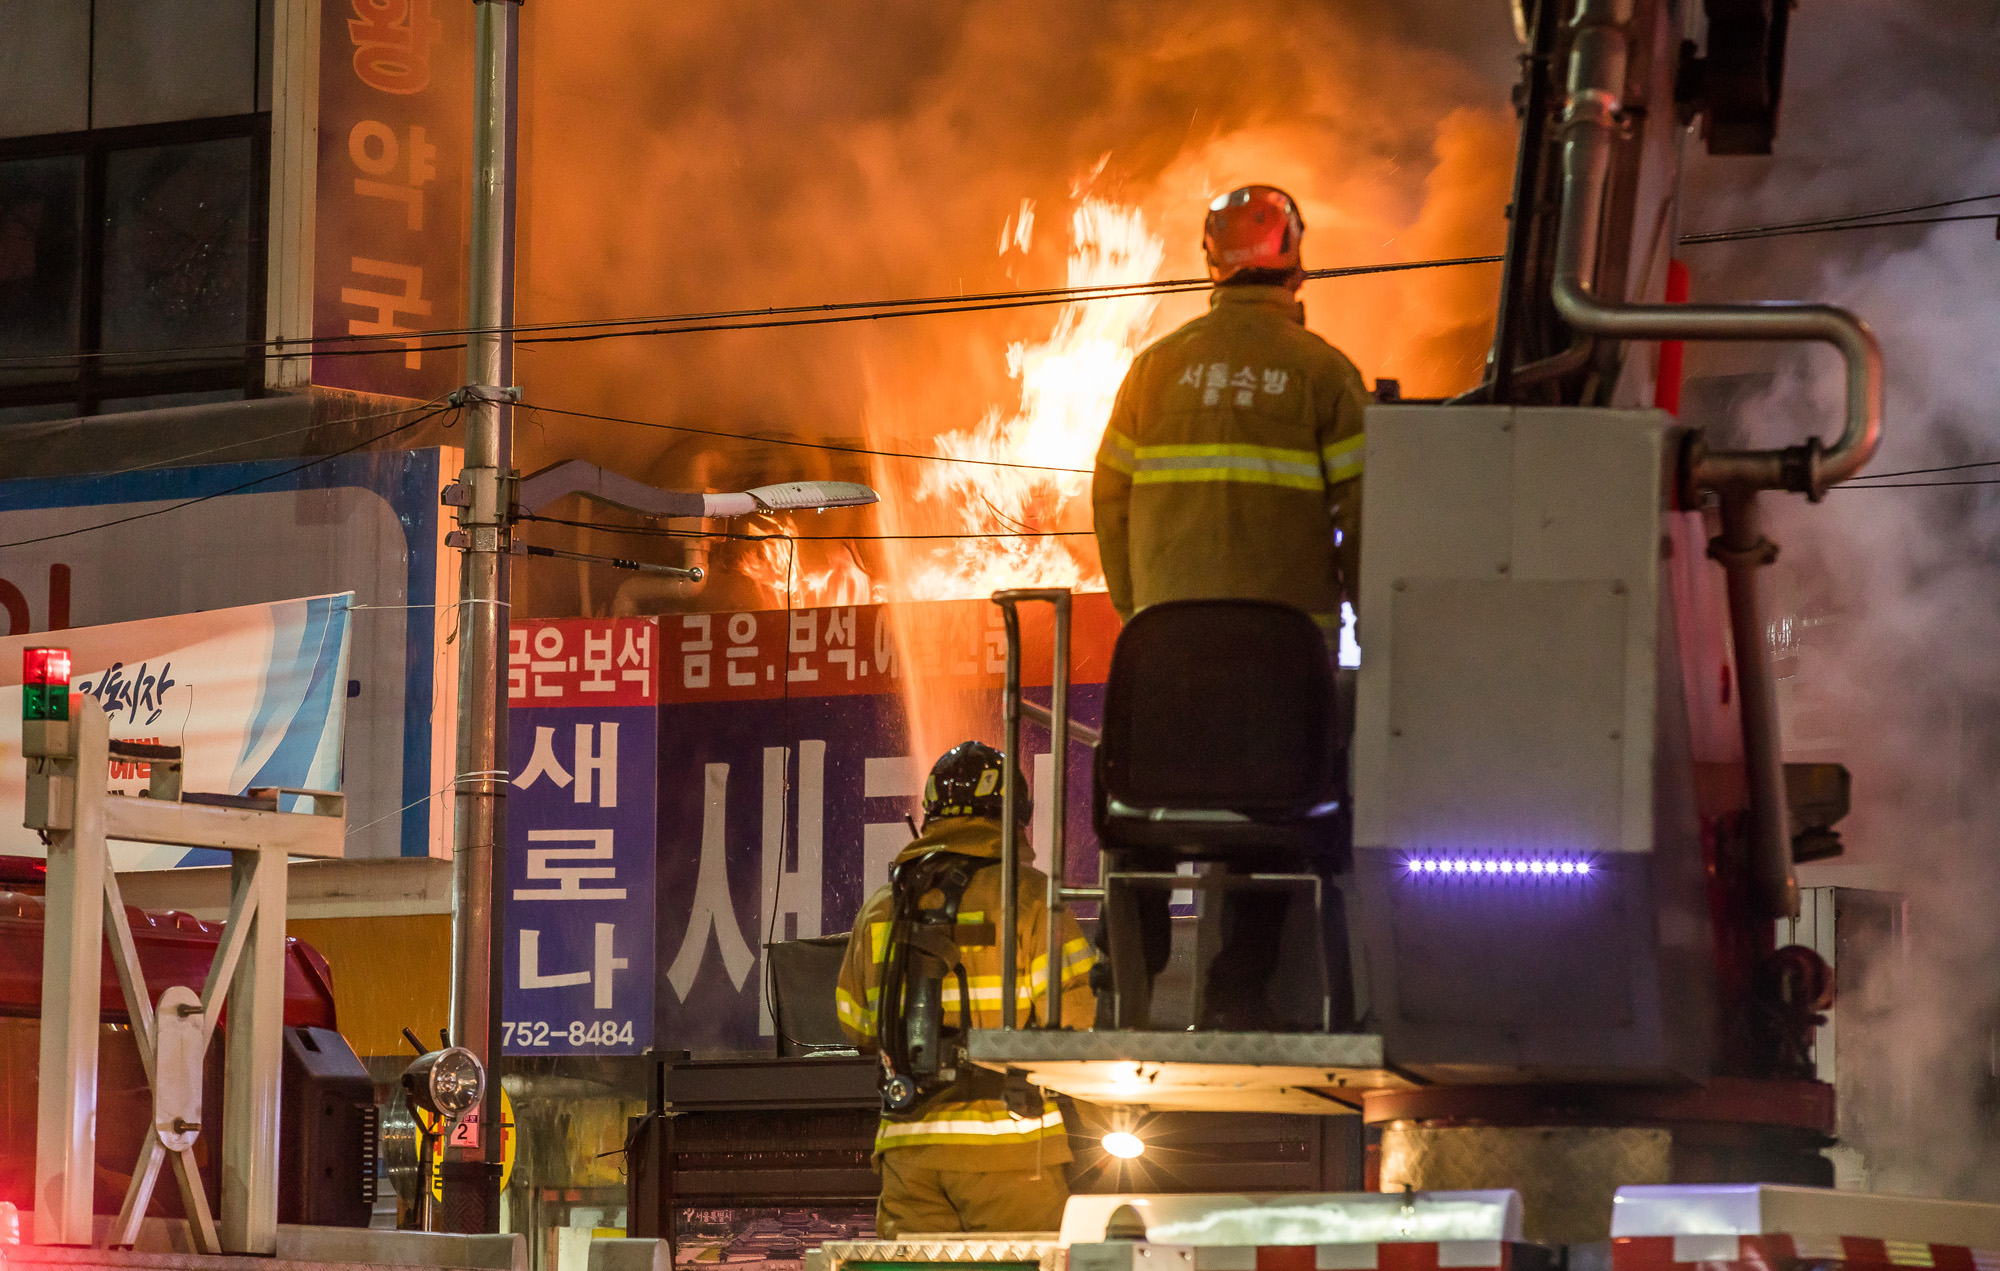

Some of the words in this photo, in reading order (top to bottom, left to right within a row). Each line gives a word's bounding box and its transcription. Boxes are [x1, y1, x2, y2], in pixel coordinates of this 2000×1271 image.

[512, 721, 629, 1010] 새로나
[502, 1020, 635, 1047] 752-8484
[457, 1123, 469, 1140] 2
[695, 1210, 732, 1223] 서울특별시
